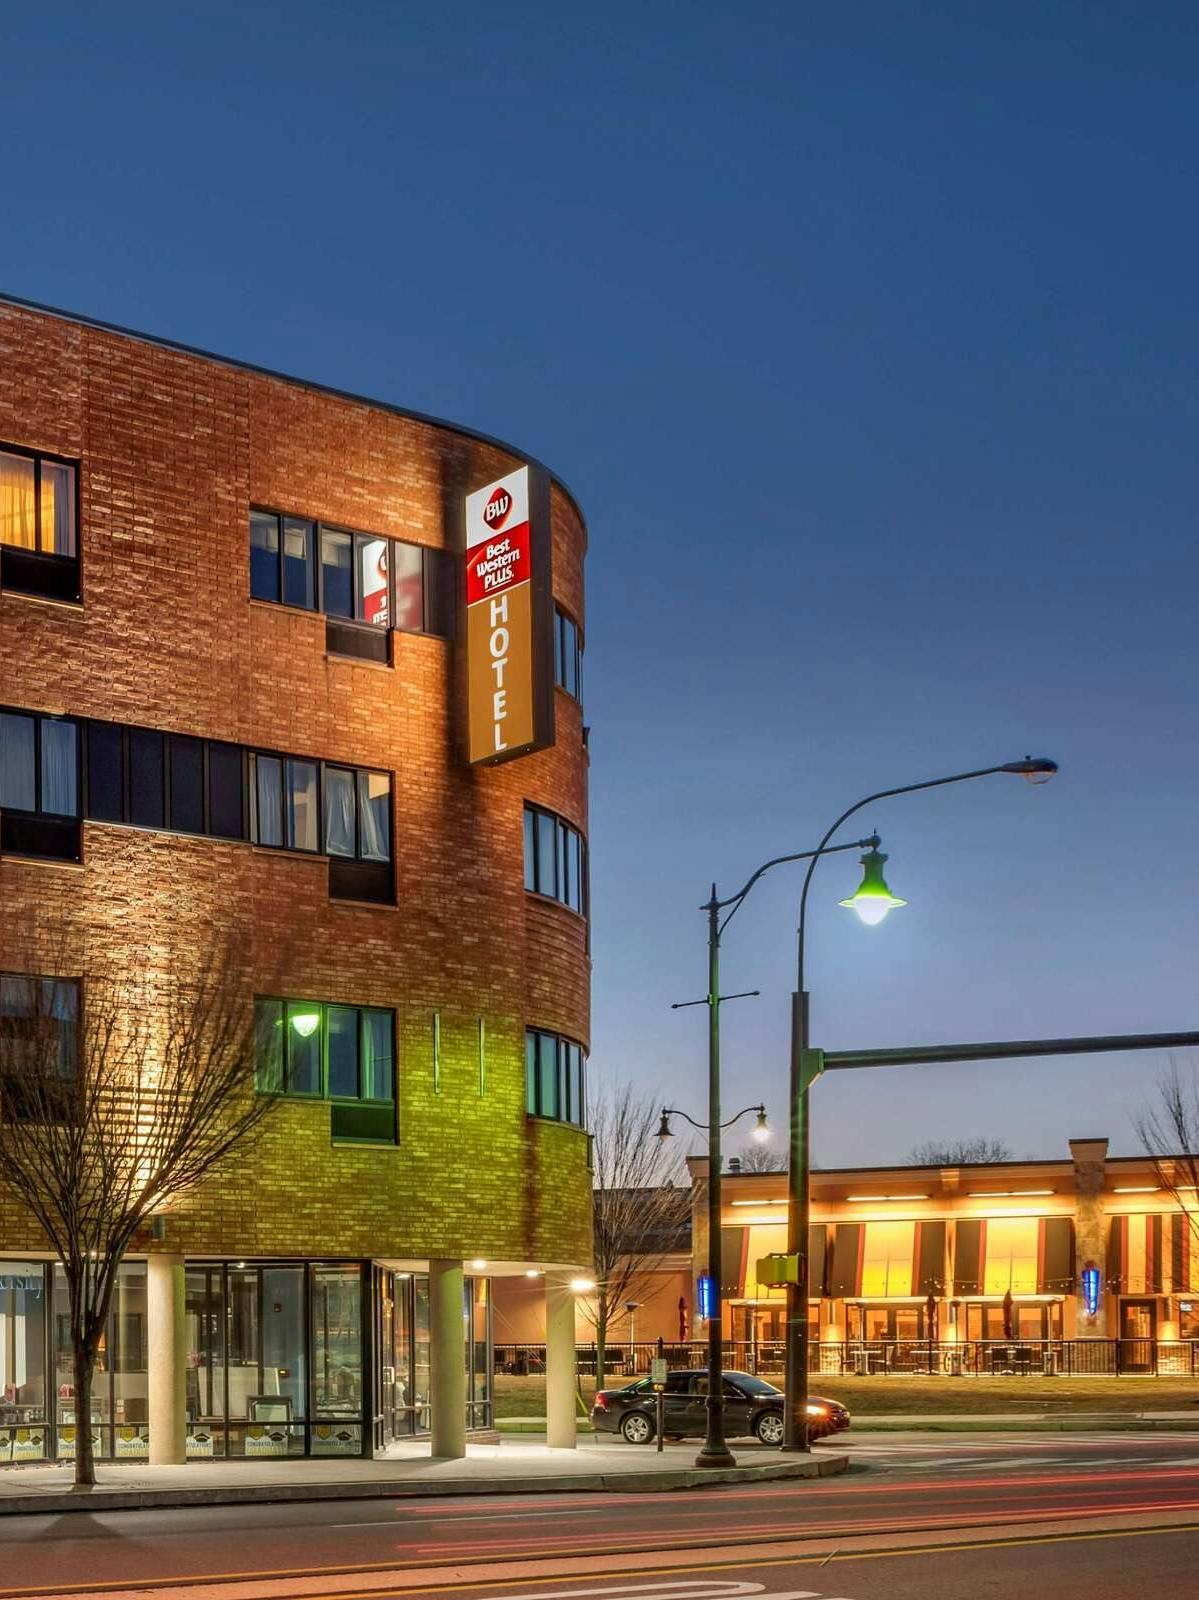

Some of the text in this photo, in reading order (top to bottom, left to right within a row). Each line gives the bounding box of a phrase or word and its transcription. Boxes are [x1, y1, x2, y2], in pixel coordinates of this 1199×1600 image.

[486, 495, 508, 521] BW
[476, 548, 520, 578] Western
[486, 538, 510, 560] Best
[489, 594, 510, 751] HOTEL
